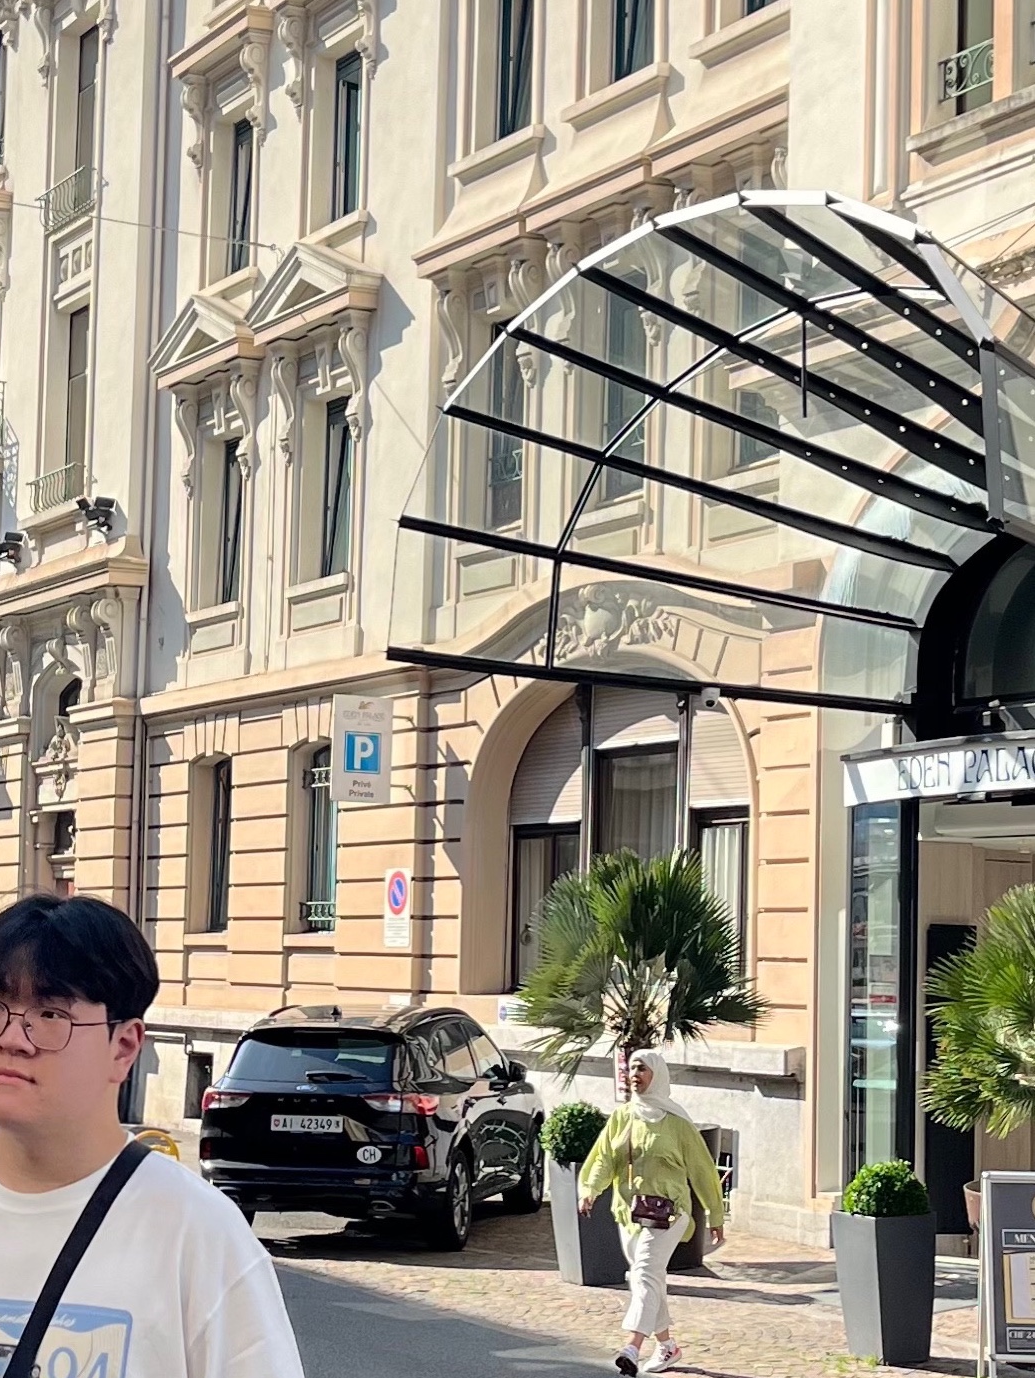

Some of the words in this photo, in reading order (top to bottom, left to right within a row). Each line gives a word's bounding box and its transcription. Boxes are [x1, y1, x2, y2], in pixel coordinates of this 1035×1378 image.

[354, 736, 374, 769] P
[897, 752, 951, 792] EDEN
[963, 746, 1035, 784] PALA
[300, 1118, 333, 1131] 42349
[362, 1148, 376, 1161] CH
